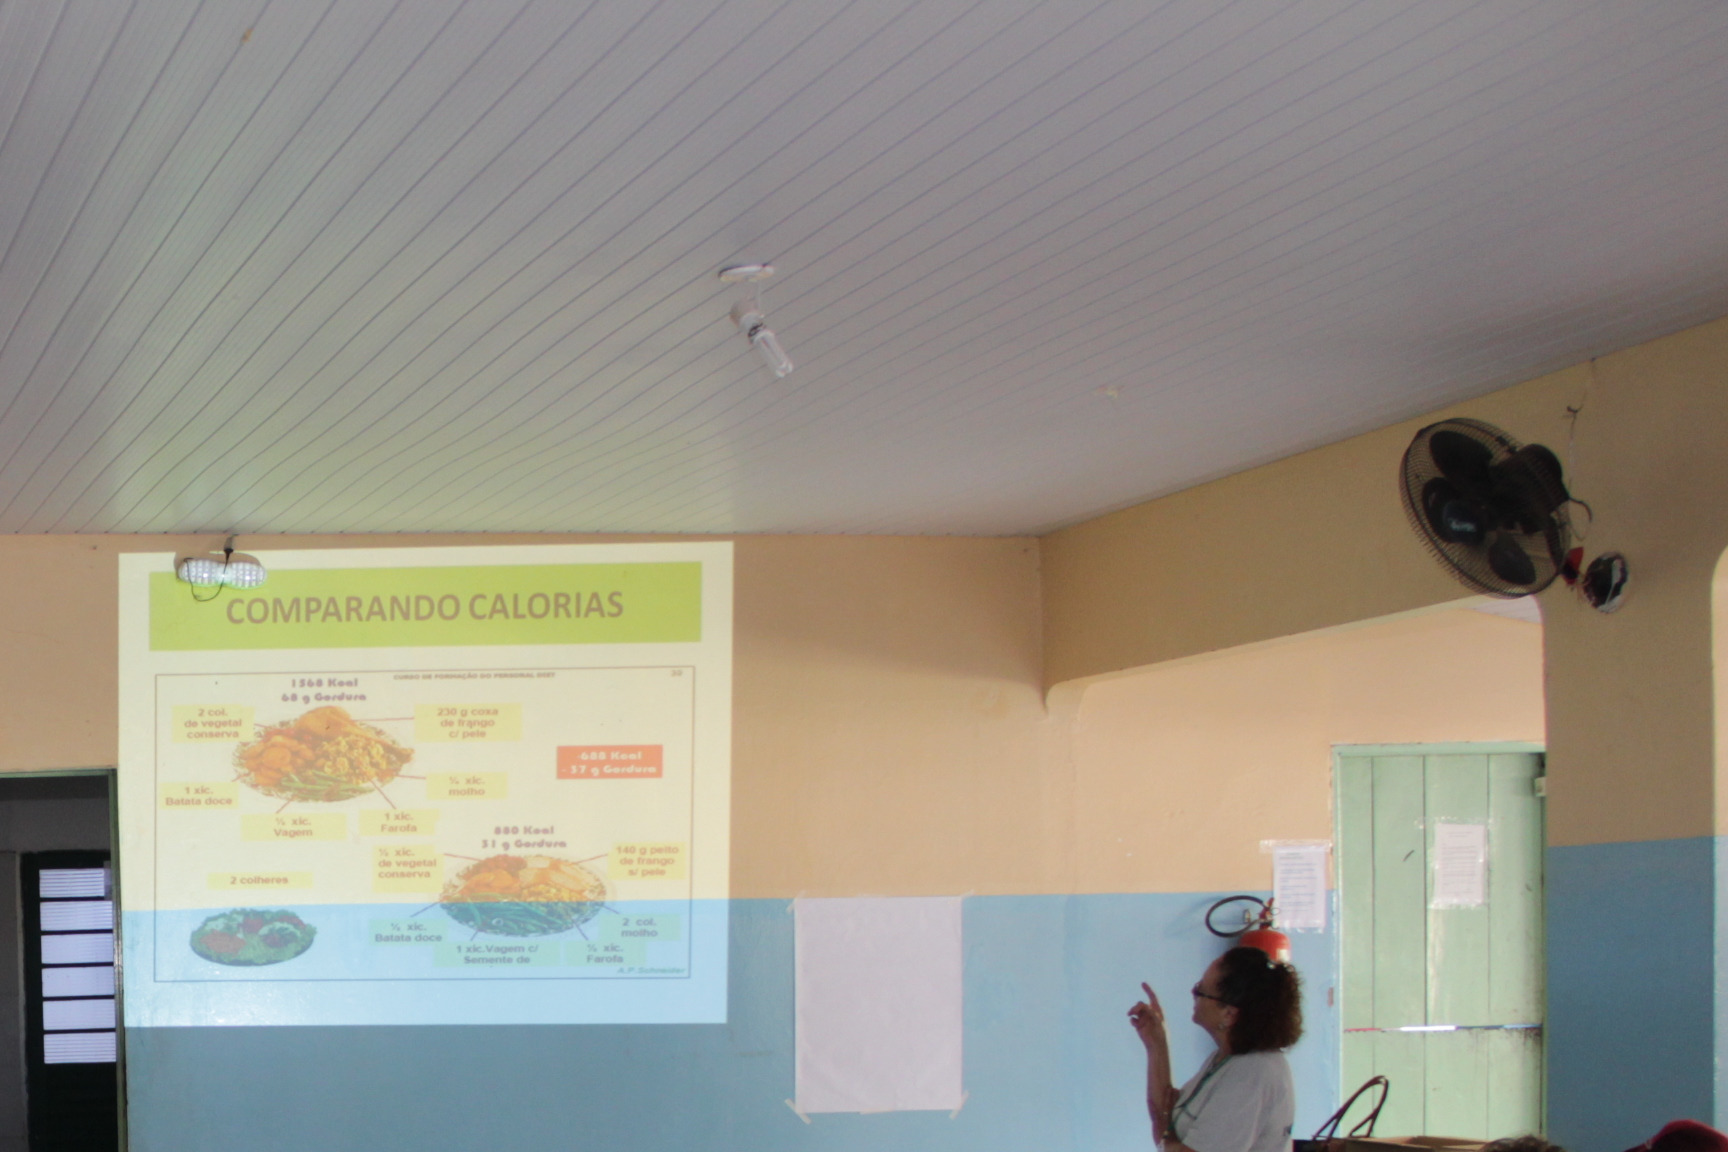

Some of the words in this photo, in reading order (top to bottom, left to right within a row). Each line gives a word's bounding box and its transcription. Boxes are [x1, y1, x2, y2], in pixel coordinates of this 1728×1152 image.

[226, 594, 460, 625] COMPARANDO
[468, 591, 624, 621] CALORIAS
[292, 679, 323, 688] 1568
[281, 693, 298, 702] 68
[314, 692, 367, 702] Gordura
[198, 708, 205, 717] 2
[208, 708, 228, 717] col.
[437, 708, 458, 717] 230
[460, 709, 468, 718] g
[471, 708, 499, 716] coxa
[184, 719, 198, 728] de
[200, 719, 242, 730] vegetal
[440, 719, 455, 728] de
[458, 718, 495, 729] frango
[187, 731, 240, 739] conserva
[449, 729, 459, 739] c/
[462, 729, 486, 740] pele
[603, 764, 657, 774] Gordura
[448, 786, 485, 796] molho
[165, 797, 202, 806] Batata
[204, 796, 232, 806] doce
[274, 828, 313, 838] Vagem
[380, 824, 417, 832] Farofa
[514, 838, 567, 848] Gordura
[616, 846, 636, 854] 140
[639, 847, 646, 856] g
[650, 844, 679, 856] peito
[378, 859, 392, 868] de
[396, 858, 437, 870] vegetal
[620, 856, 634, 865] de
[637, 856, 675, 867] frango
[378, 870, 431, 879] conserva
[628, 867, 639, 876] s/
[642, 867, 666, 878] pele
[230, 876, 237, 885] 2
[240, 876, 289, 885] colheres
[622, 918, 630, 926] 2
[636, 918, 657, 926] col.
[375, 934, 412, 942] Batata
[414, 934, 442, 942] doce
[622, 928, 658, 938] molho
[528, 944, 539, 954] c/
[464, 956, 516, 964] Semente
[518, 955, 531, 964] de
[587, 954, 624, 964] Farofa
